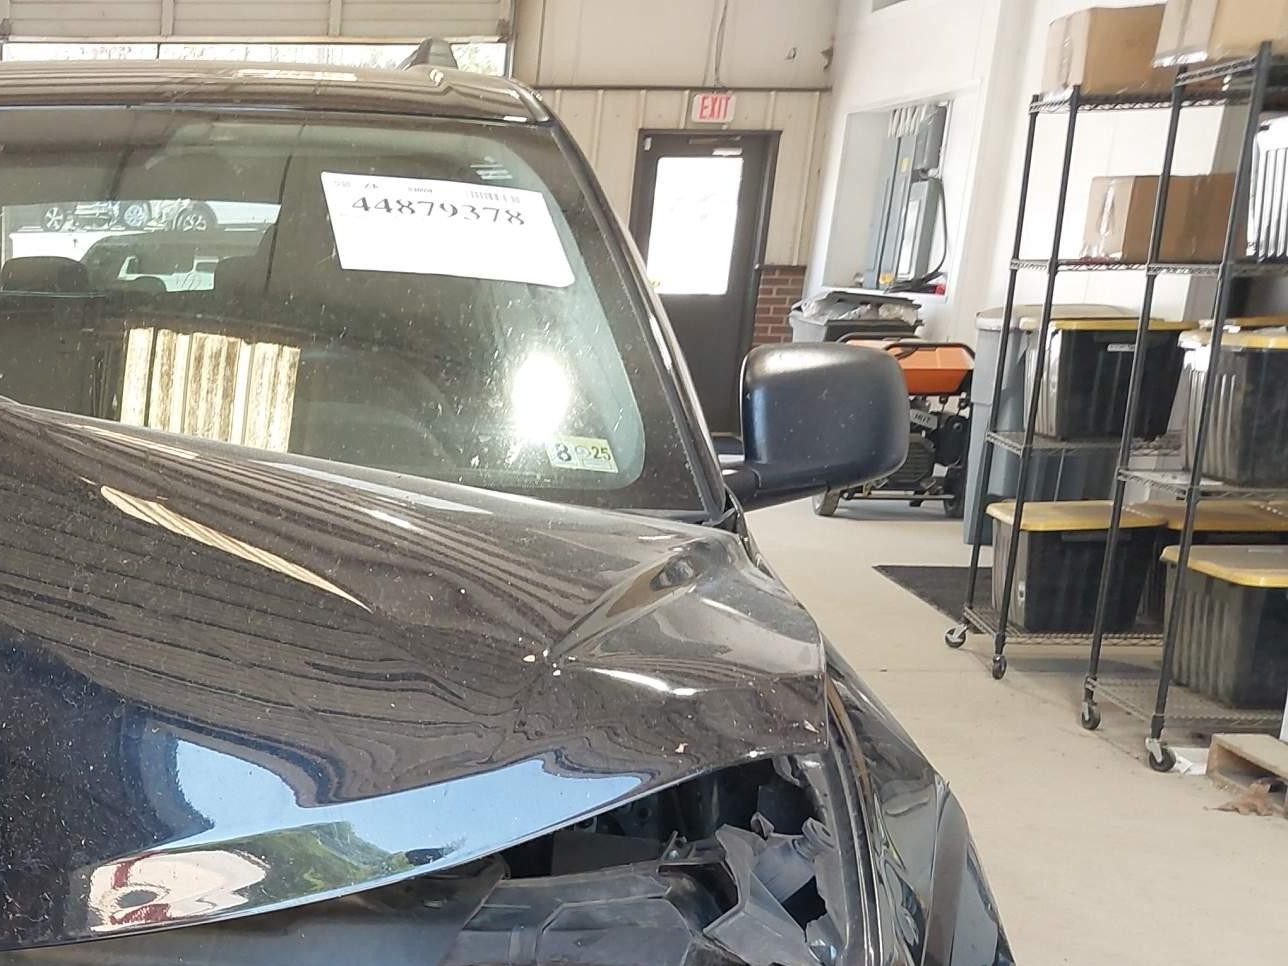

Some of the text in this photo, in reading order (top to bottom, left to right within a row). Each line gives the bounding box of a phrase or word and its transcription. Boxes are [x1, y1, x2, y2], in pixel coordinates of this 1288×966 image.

[697, 95, 731, 120] EXIT
[351, 196, 525, 226] 44879378
[555, 442, 611, 462] 8 25
